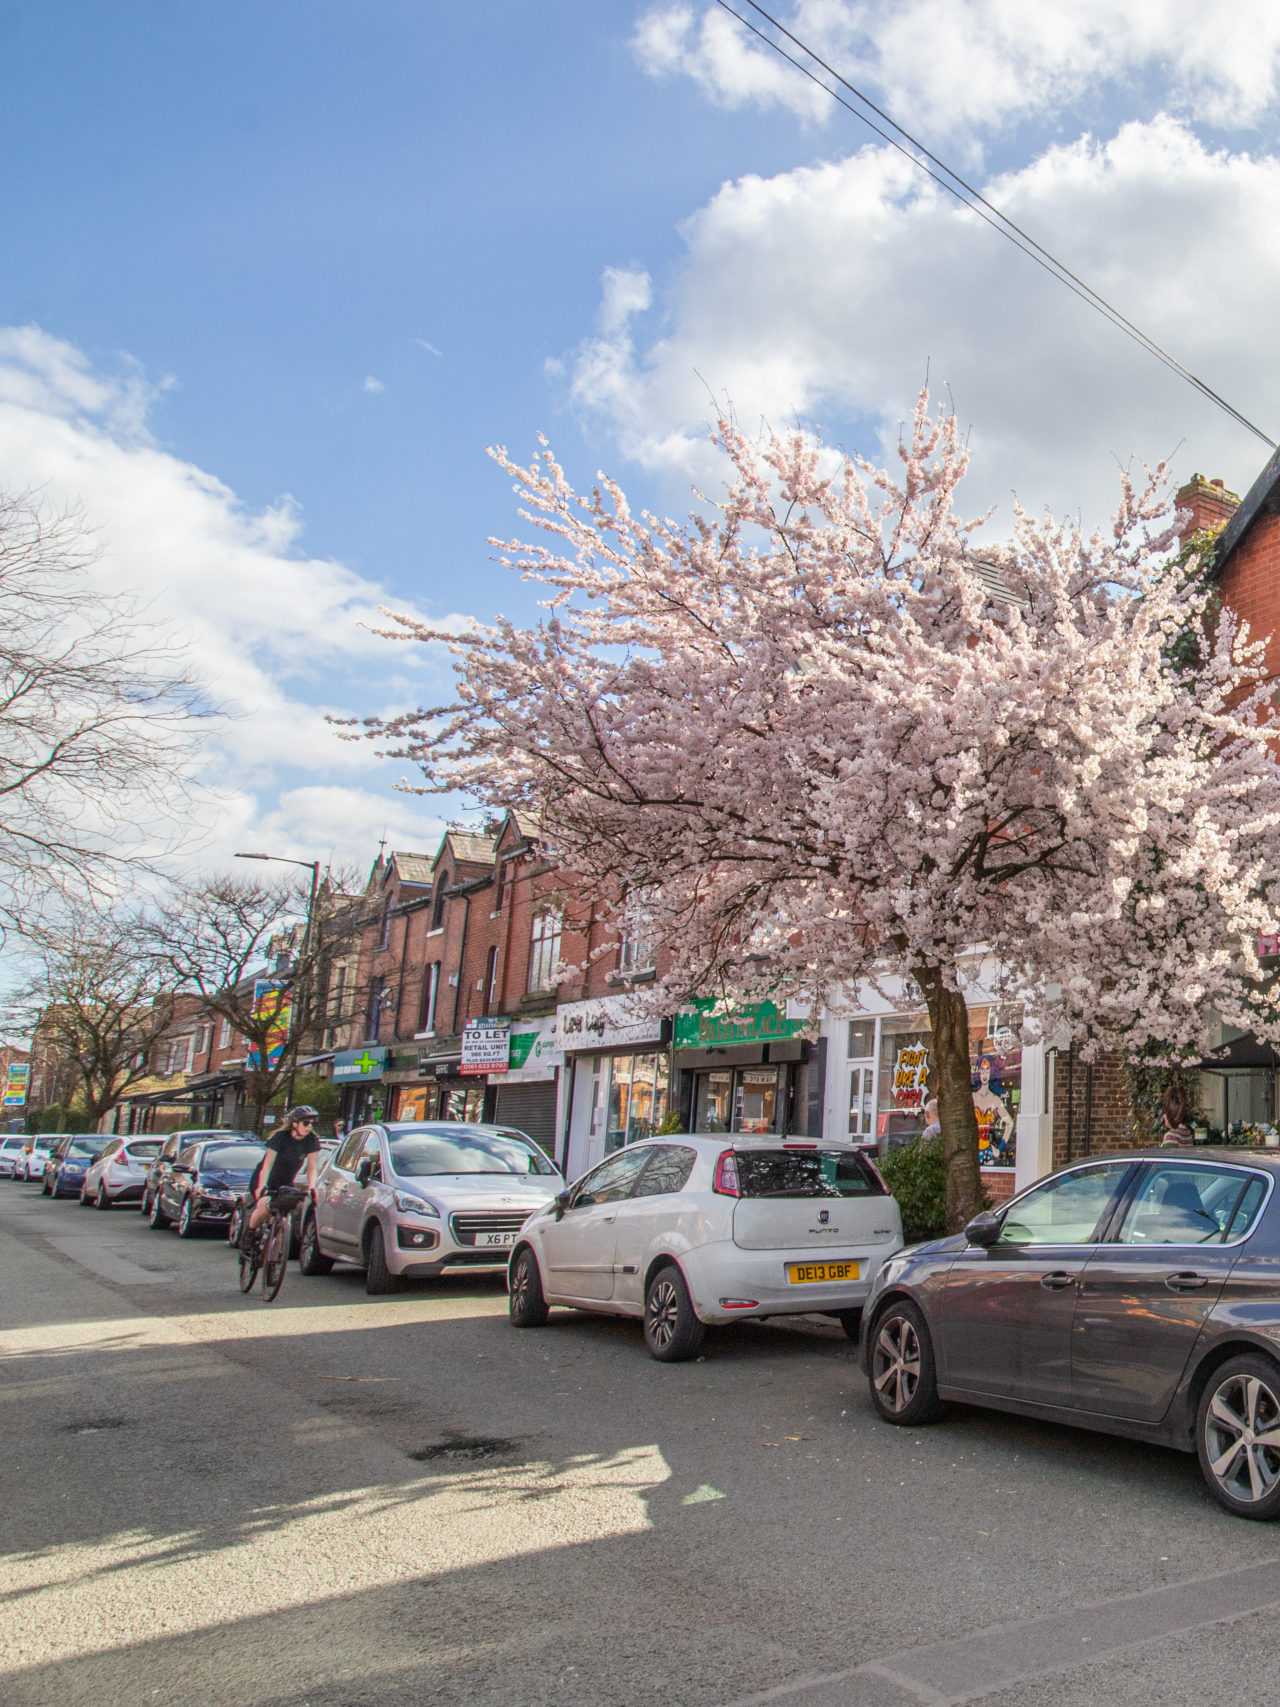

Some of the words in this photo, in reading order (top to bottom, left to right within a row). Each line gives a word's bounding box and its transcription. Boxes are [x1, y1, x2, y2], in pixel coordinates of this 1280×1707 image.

[465, 1031, 482, 1040] TO
[485, 1030, 509, 1039] LET
[899, 1049, 927, 1069] FIGHT
[895, 1069, 917, 1088] LIKE
[918, 1067, 927, 1087] A
[487, 1234, 501, 1244] X6
[797, 1265, 826, 1282] DE13
[828, 1264, 852, 1280] GBF
